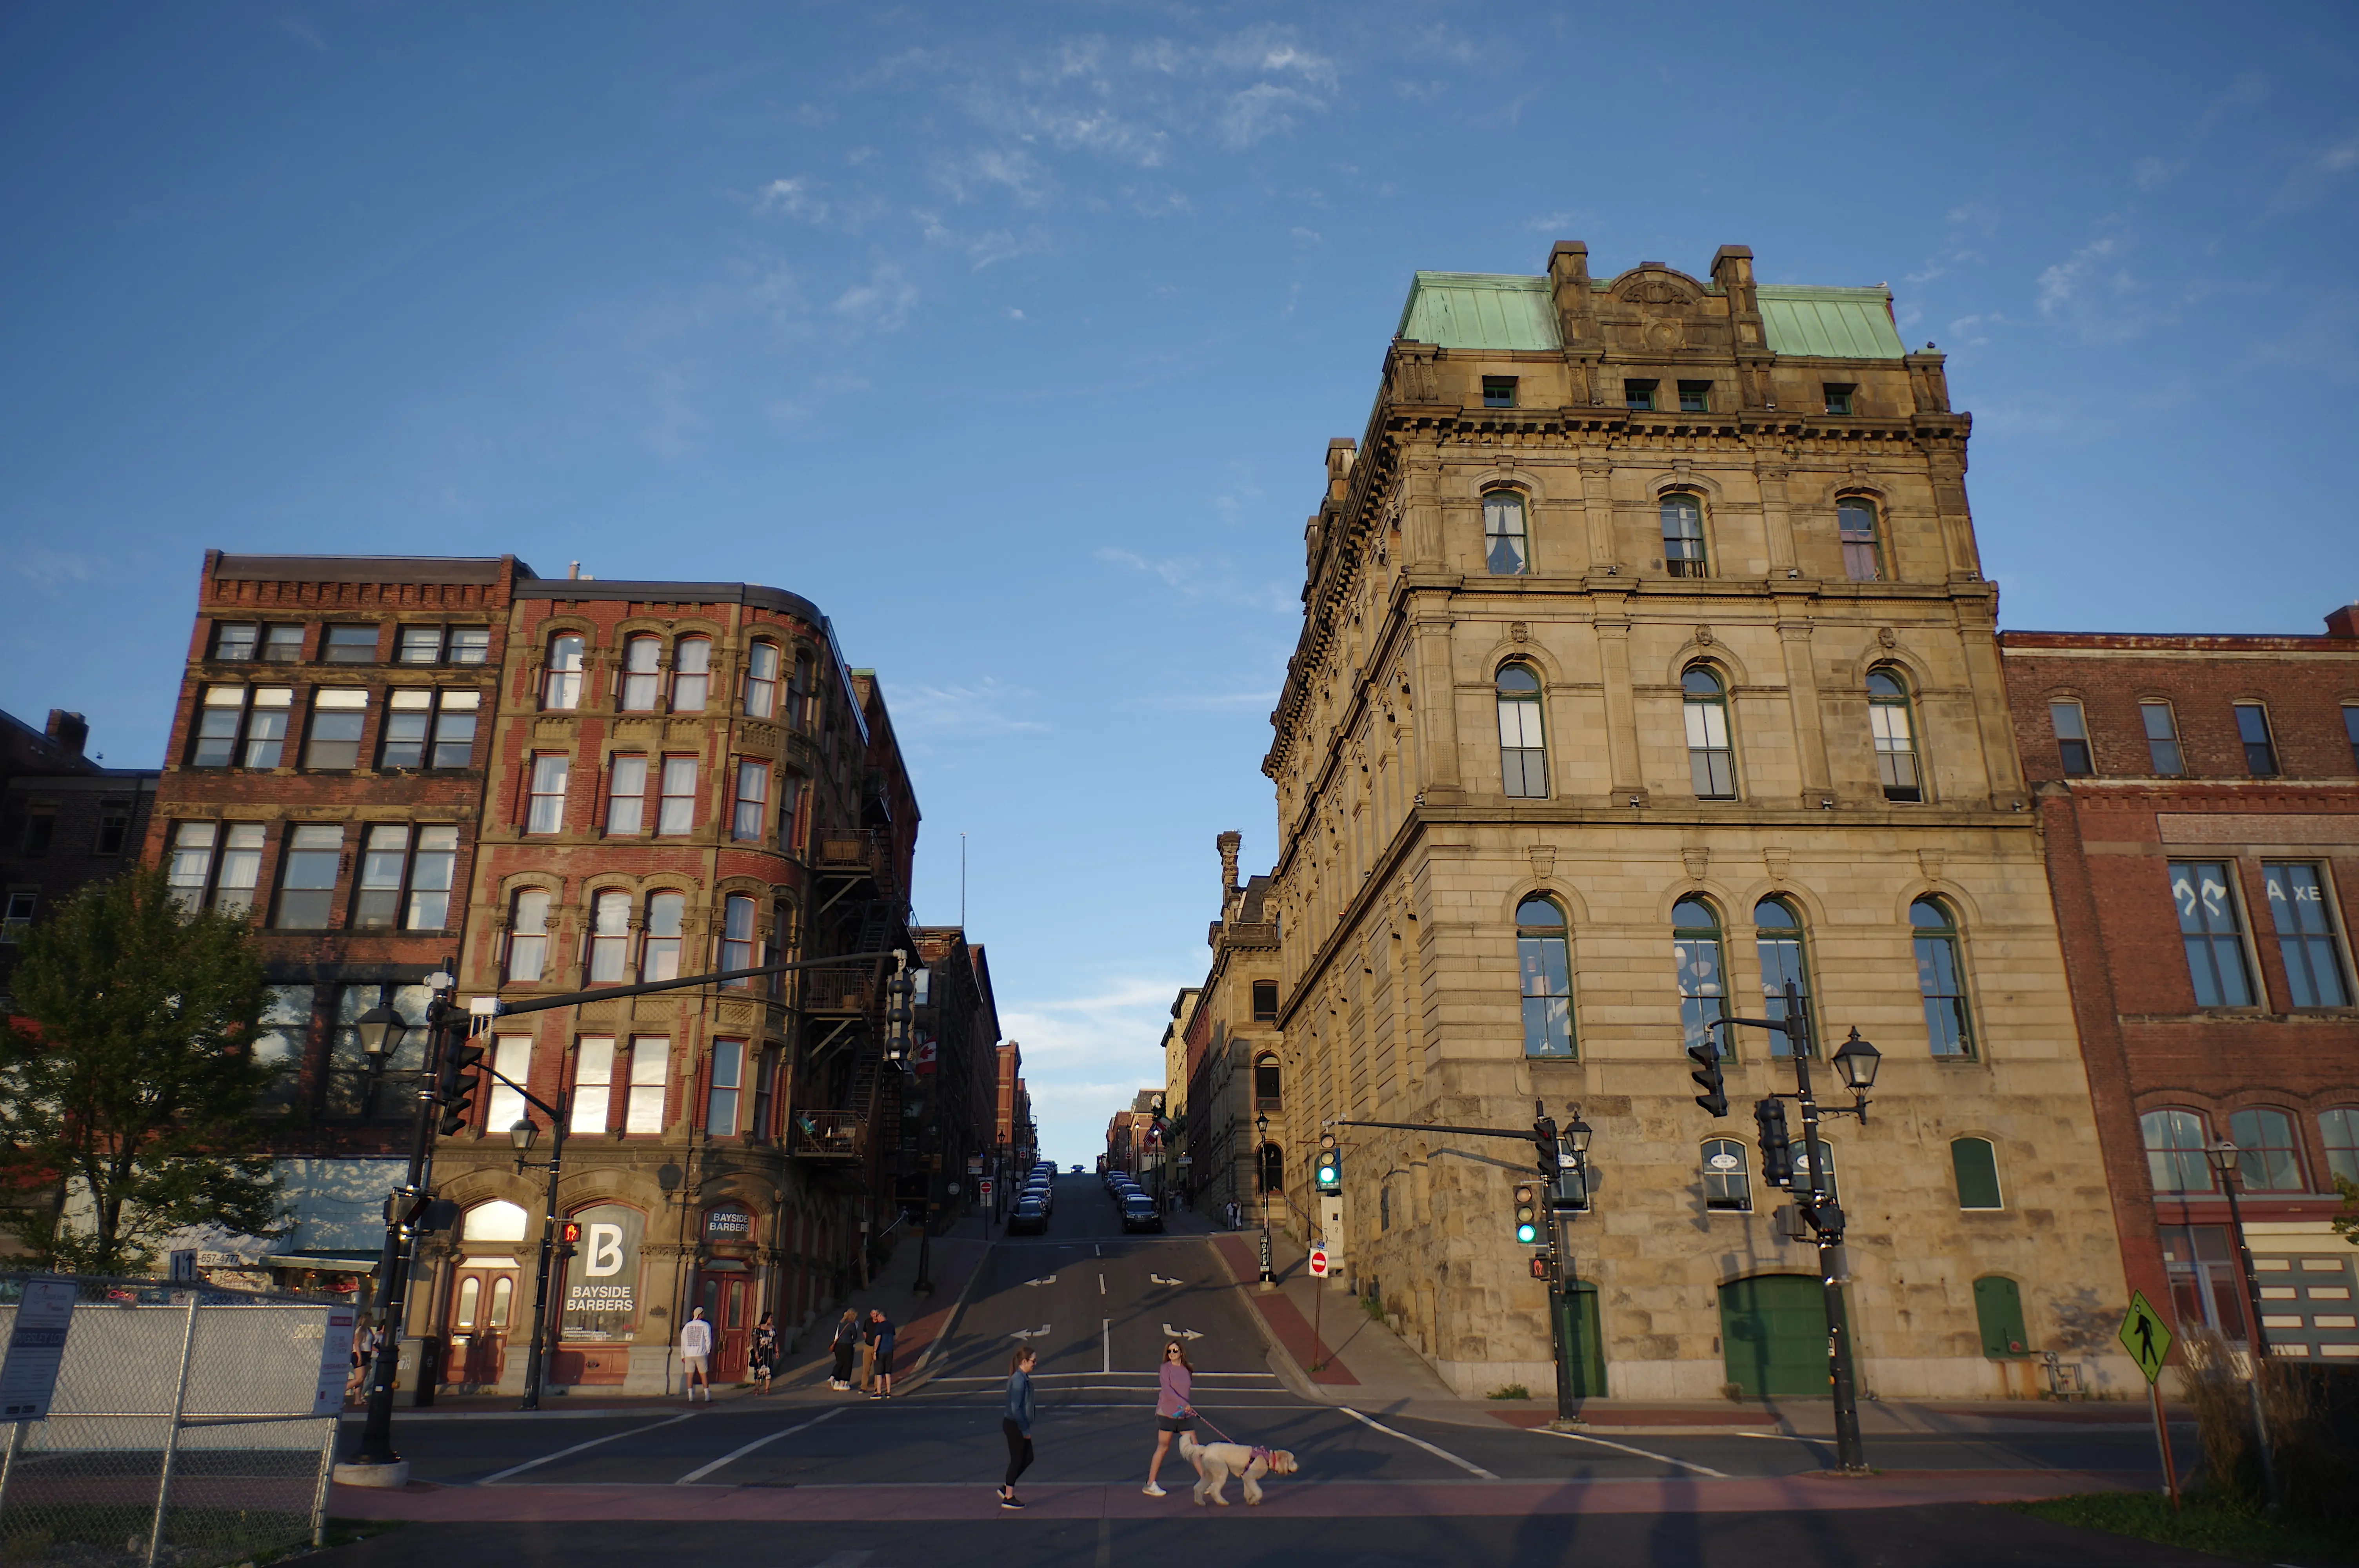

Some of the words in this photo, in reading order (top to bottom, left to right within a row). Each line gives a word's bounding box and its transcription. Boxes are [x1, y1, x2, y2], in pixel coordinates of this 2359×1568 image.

[714, 1213, 748, 1223] BAYSIDE
[709, 1222, 748, 1232] BARBERS
[586, 1224, 623, 1277] B
[108, 1289, 137, 1301] OPEN
[572, 1286, 631, 1298] BAYSIDE
[567, 1299, 634, 1312] BARBERS
[13, 1333, 50, 1343] PUGSLEY
[49, 1332, 65, 1343] LOT
